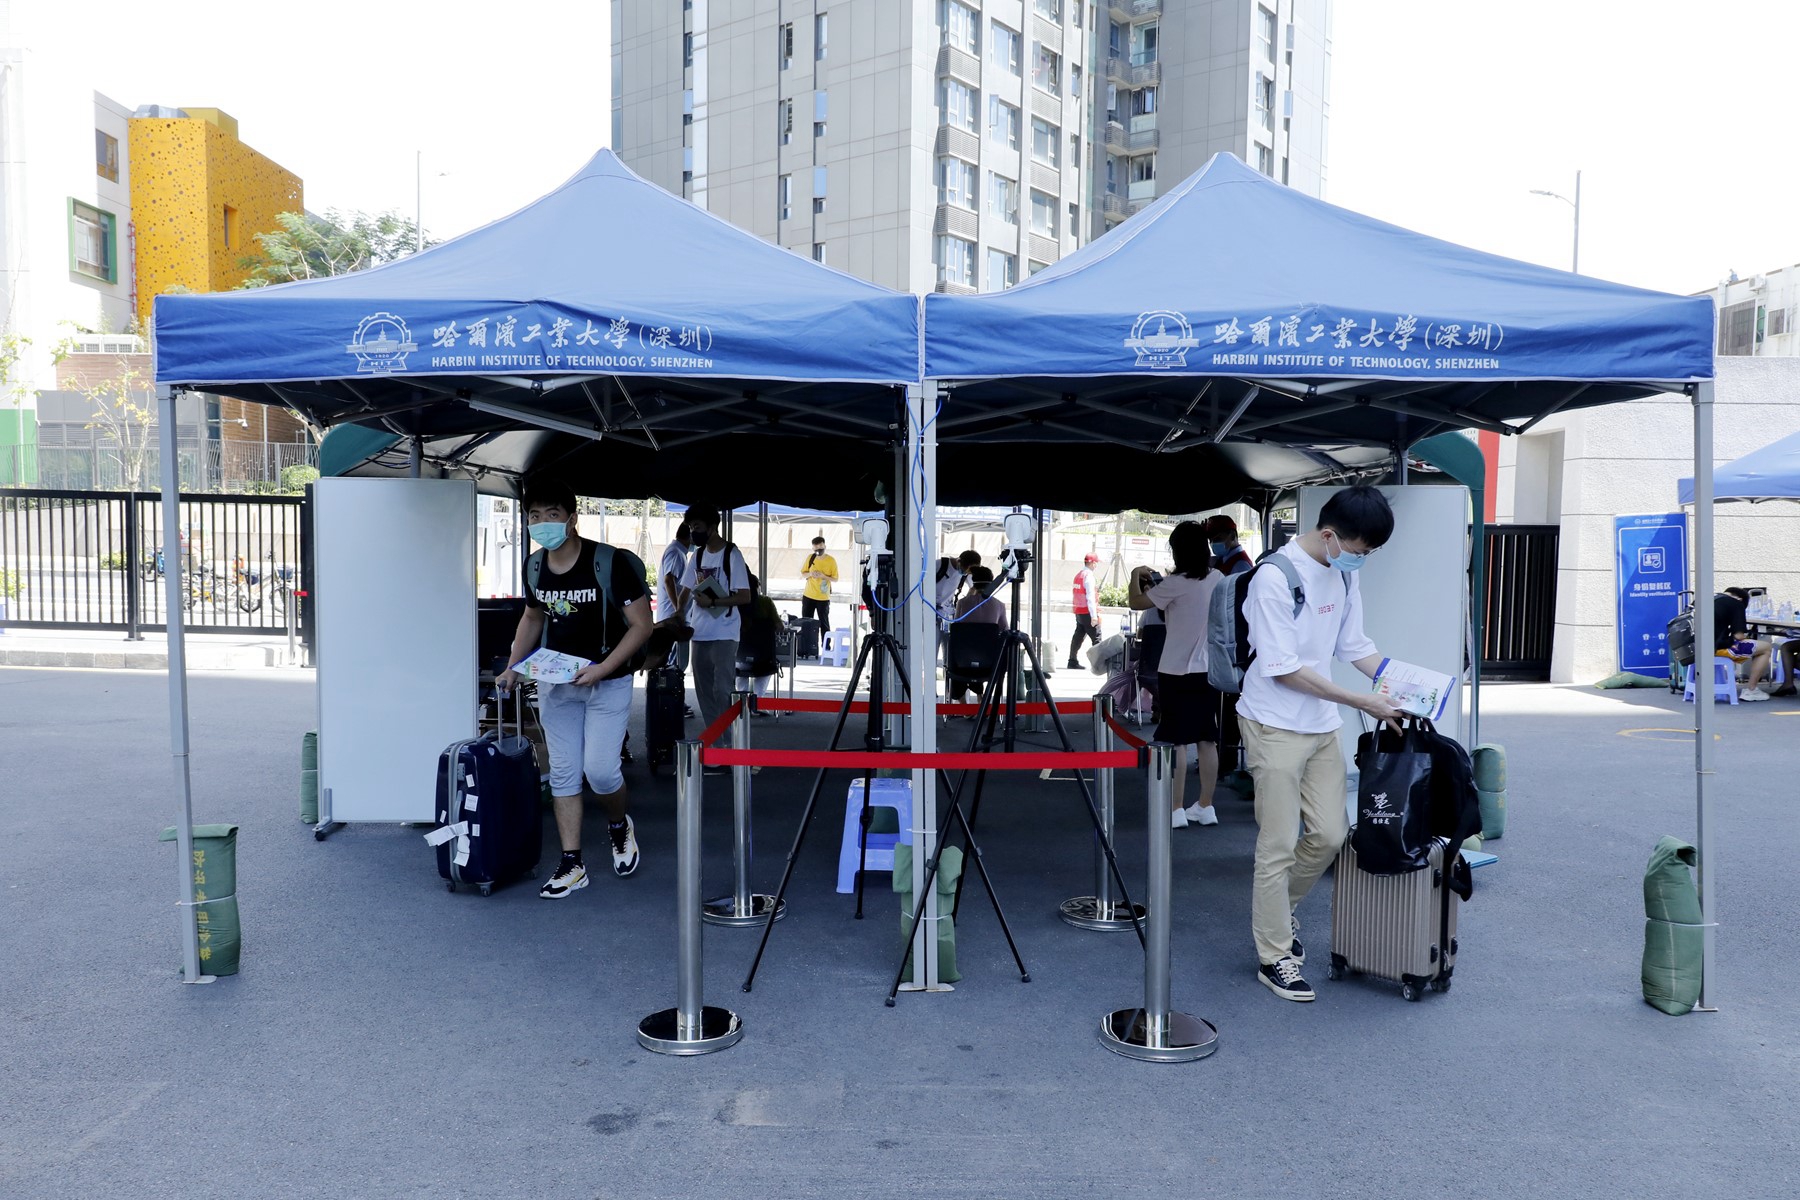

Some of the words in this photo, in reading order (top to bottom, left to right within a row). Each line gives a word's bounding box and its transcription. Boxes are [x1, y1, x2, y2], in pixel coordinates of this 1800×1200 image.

[432, 355, 476, 367] HARBIN
[481, 354, 542, 367] INSTITUTE
[546, 355, 561, 367] OF
[566, 355, 646, 368] TECHNOLOGY,
[651, 358, 713, 369] SHENZHEN
[1213, 353, 1256, 366] HARBIN
[1264, 354, 1324, 367] INSTITUTE
[1329, 355, 1345, 367] OF
[1350, 356, 1431, 370] TECHNOLOGY,
[1435, 358, 1499, 369] SHENZHEN
